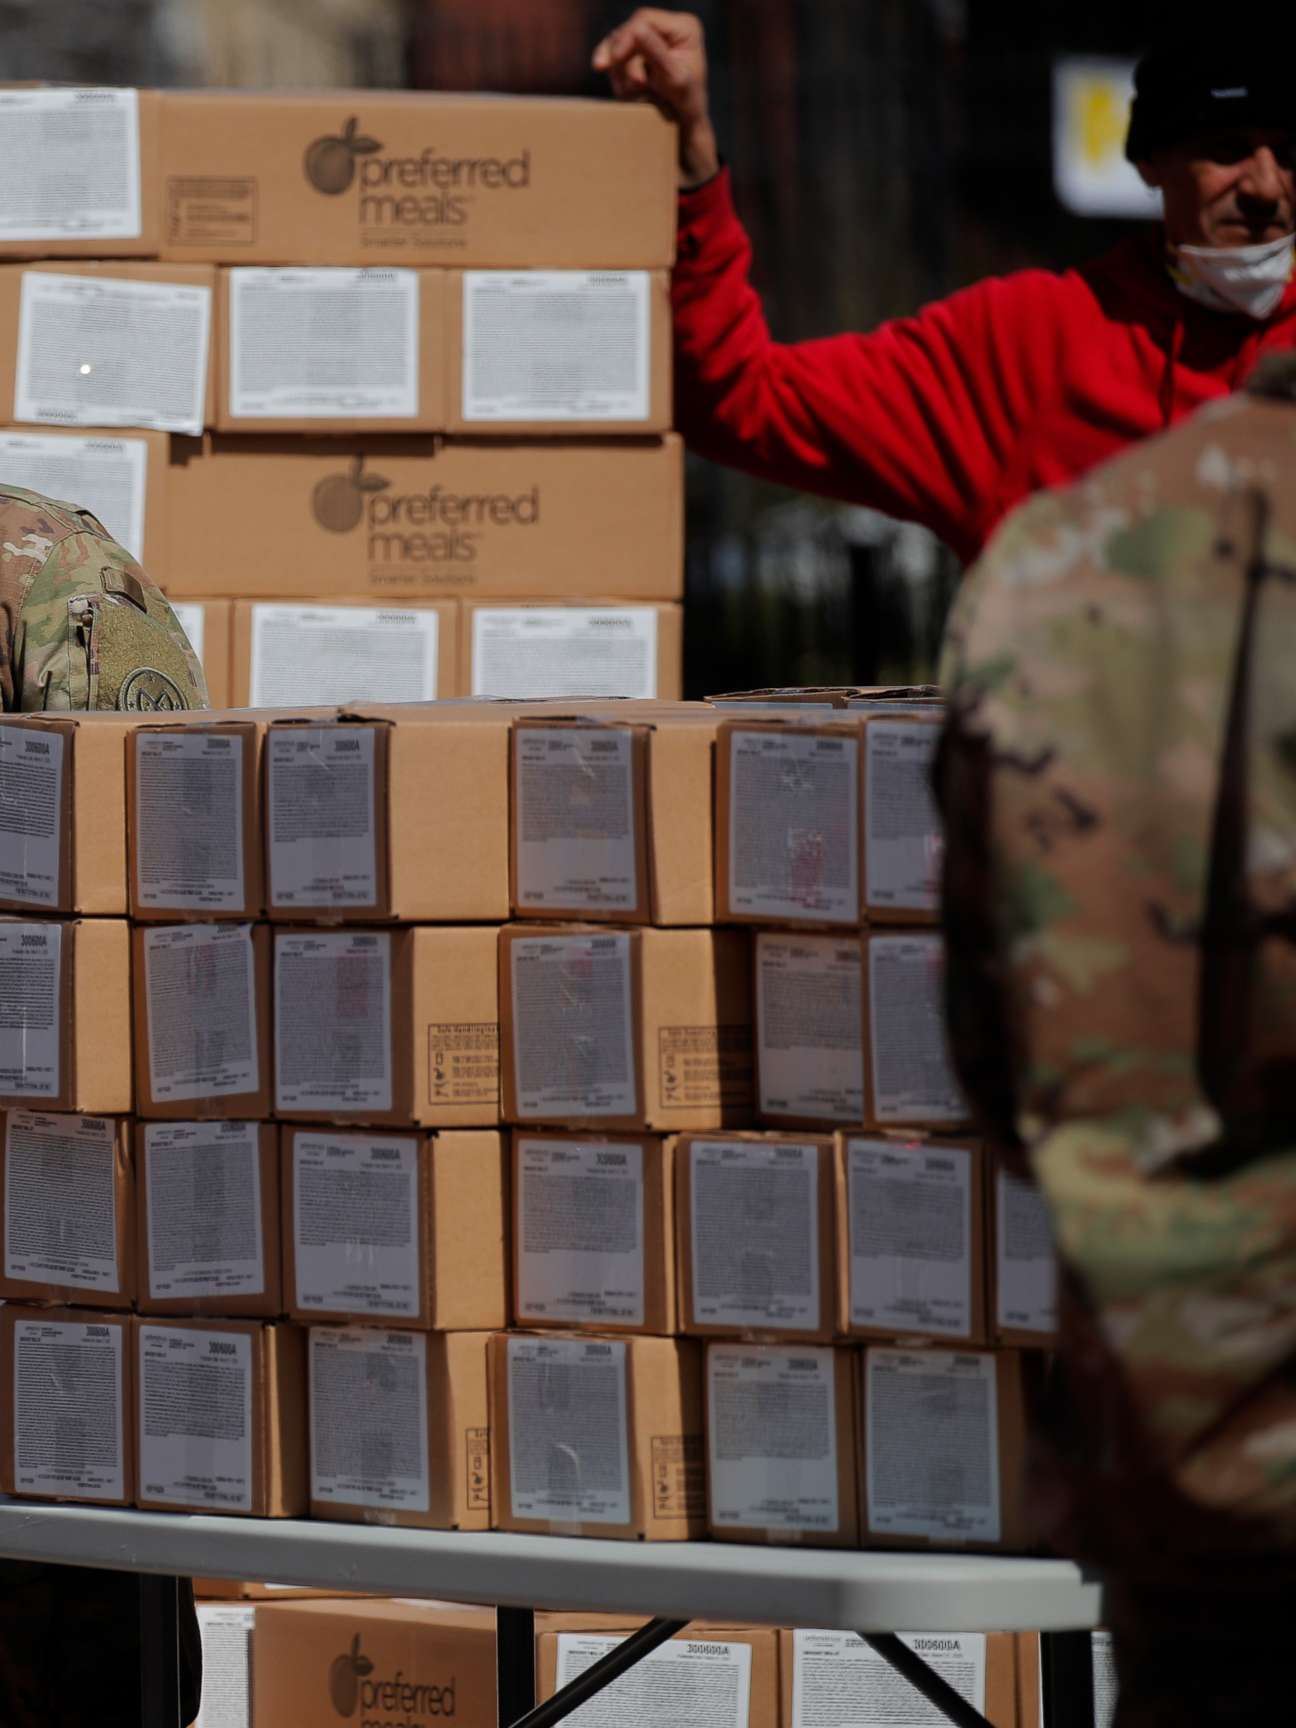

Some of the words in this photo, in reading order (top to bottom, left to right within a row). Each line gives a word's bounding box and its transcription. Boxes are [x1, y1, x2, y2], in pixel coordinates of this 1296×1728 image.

[360, 148, 531, 194] preferred
[360, 190, 469, 226] meals
[368, 485, 540, 533] preferred
[368, 527, 476, 562] meals
[363, 1672, 456, 1717] preferred
